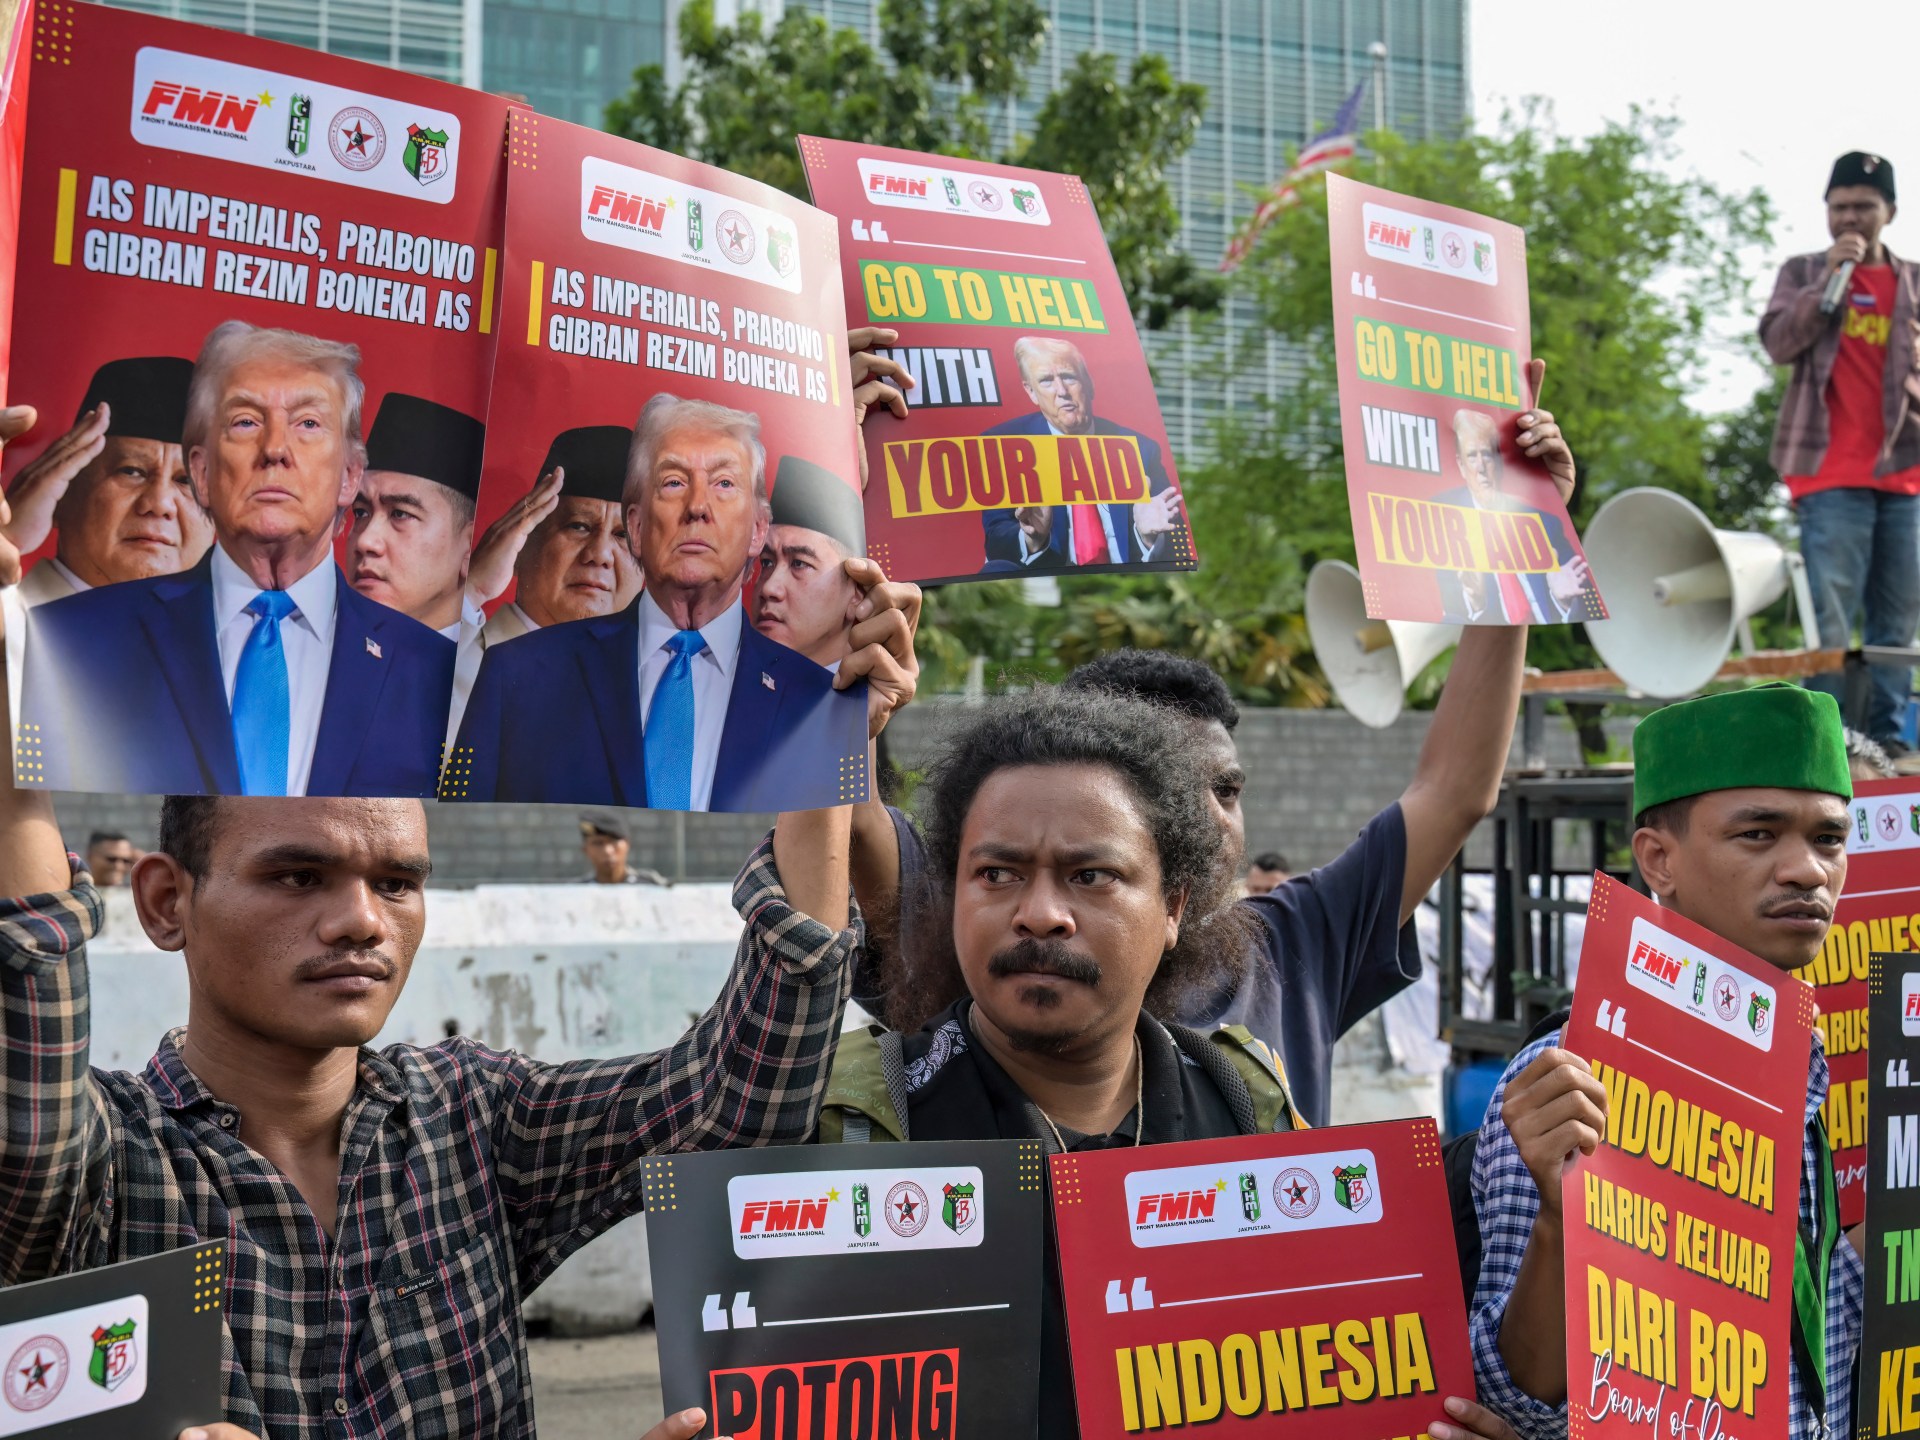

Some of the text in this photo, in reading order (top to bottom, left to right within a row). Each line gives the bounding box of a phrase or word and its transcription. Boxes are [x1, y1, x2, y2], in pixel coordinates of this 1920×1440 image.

[141, 115, 248, 141] FRONT MAHASISWA NASIONAL
[142, 80, 259, 133] FMN
[274, 158, 316, 172] JAKPUSTARA
[869, 173, 927, 197] FMN
[86, 175, 475, 285] AS IMPERIALIS, PRABOWO
[587, 215, 605, 225] FRONT
[637, 227, 662, 239] NASIONAL
[588, 185, 667, 232] FMN
[1368, 221, 1411, 248] FMN
[83, 228, 472, 333] GIBRAN REZIM BONEKA AS
[863, 263, 1105, 330] GO TO HELL
[551, 266, 822, 362] AS IMPERIALIS, PRABOWO
[549, 314, 827, 404] GIBRAN REZIM BONEKA AS
[1356, 320, 1519, 407] GO TO HELL
[1361, 404, 1440, 473] WITH
[888, 436, 1145, 513] YOUR AID
[1370, 495, 1556, 572] YOUR AID
[1632, 940, 1682, 985] FMN
[1813, 1007, 1868, 1056] ARUS
[1590, 1058, 1776, 1212] NDONESIA
[740, 1198, 828, 1234] FMN
[740, 1233, 760, 1241] FRONT
[761, 1231, 797, 1239] MAHASISWA
[1136, 1188, 1217, 1224] FMN
[1155, 1221, 1188, 1229] MAHASISWA
[1188, 1218, 1215, 1226] NASIONAL
[1237, 1224, 1271, 1233] JAKPUSTARA
[1584, 1170, 1770, 1301] HARUS KELUAR
[847, 1241, 880, 1249] JAKPUSTARA
[1587, 1264, 1767, 1416] DARI BOP
[714, 1352, 955, 1440] POTONG
[1115, 1312, 1437, 1432] INDONESIA
[1586, 1348, 1665, 1440] Board
[1670, 1398, 1694, 1440] of
